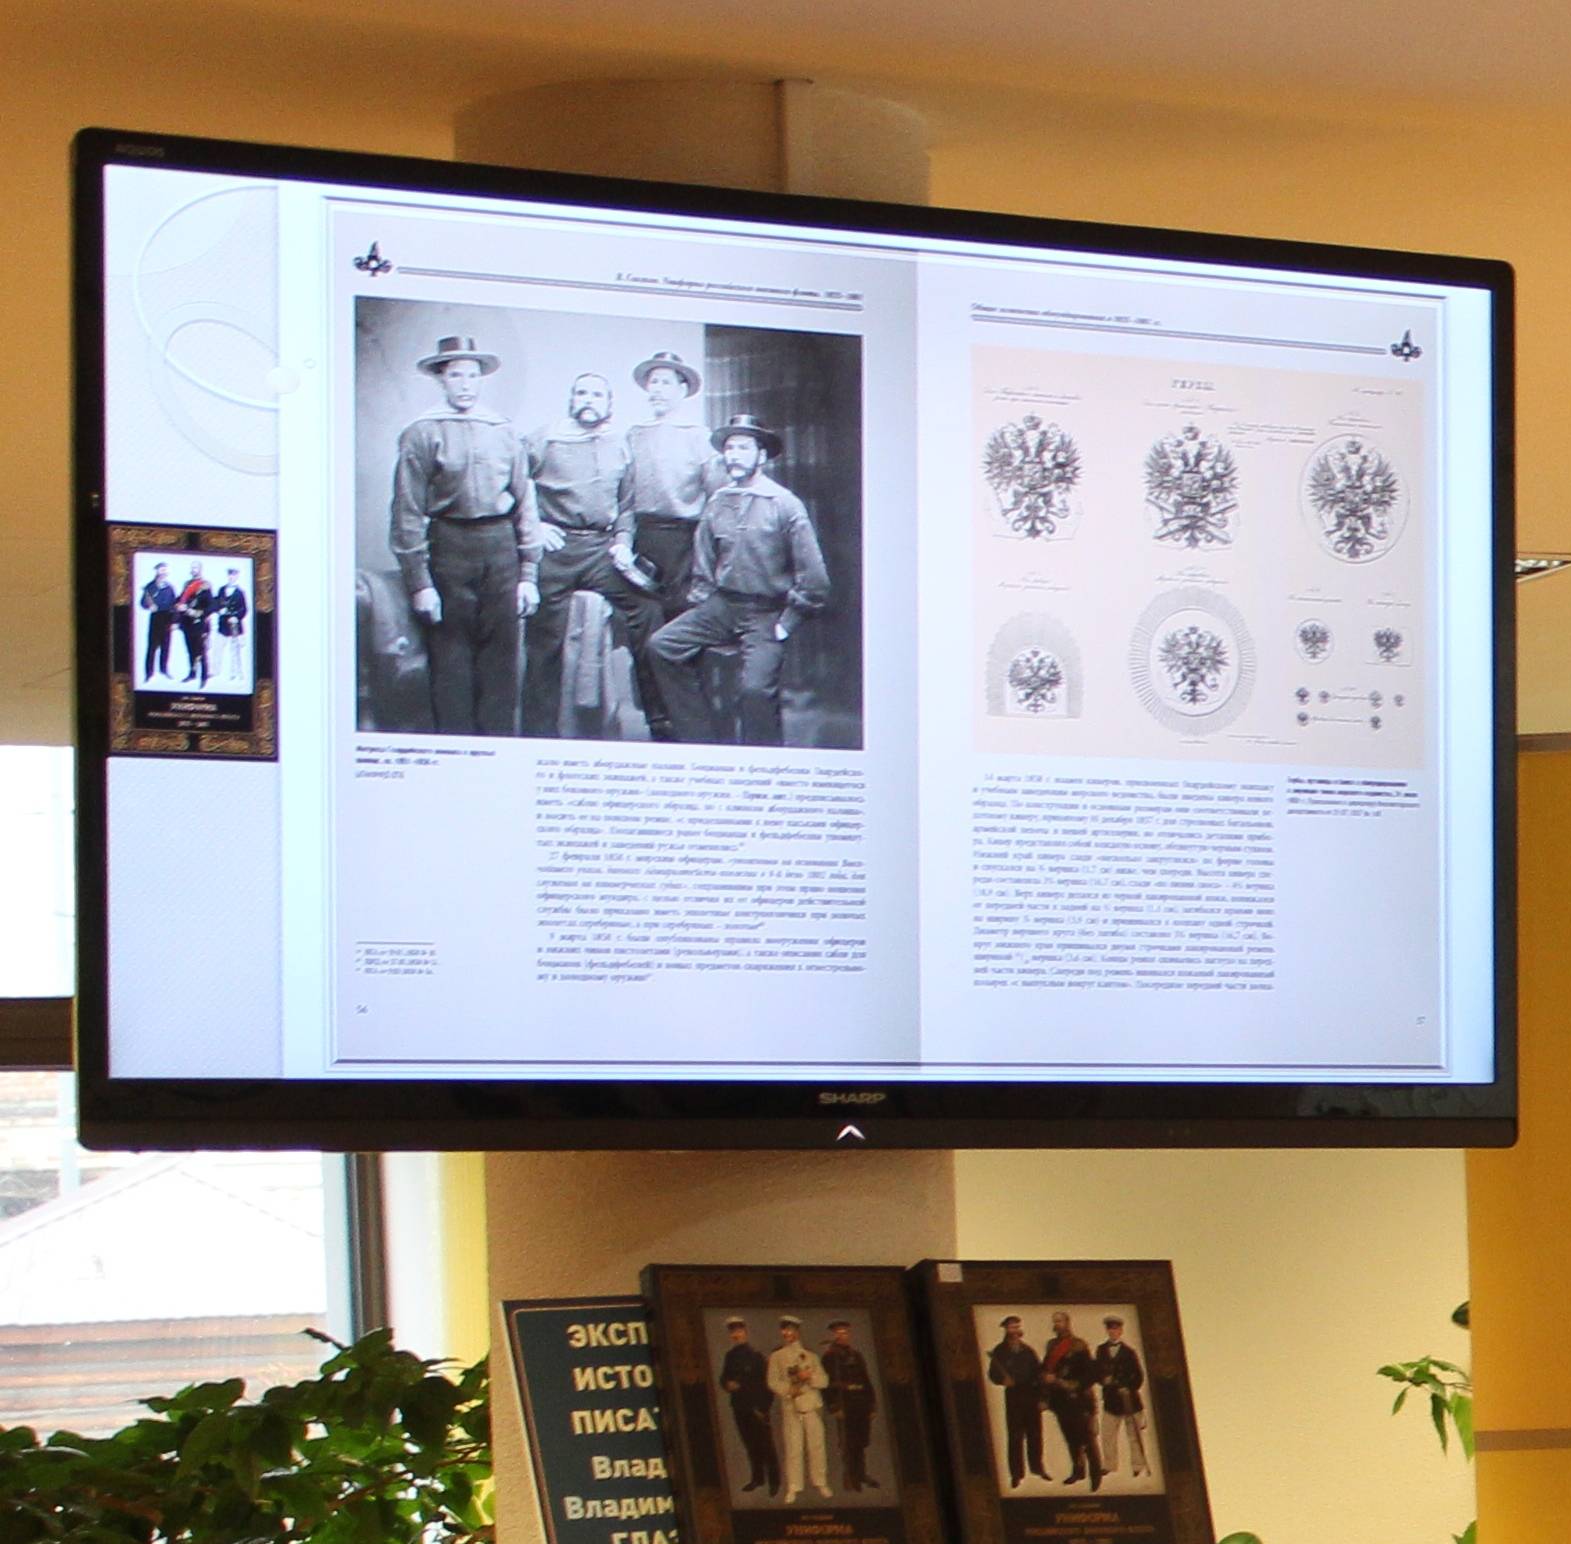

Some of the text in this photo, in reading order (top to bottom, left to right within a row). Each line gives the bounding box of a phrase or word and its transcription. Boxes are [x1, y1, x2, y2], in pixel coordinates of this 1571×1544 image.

[819, 1092, 886, 1104] SHARP
[567, 1321, 649, 1348] ЭКСП
[573, 1364, 654, 1391] ИСТО
[571, 1407, 660, 1435] ПИСА
[591, 1455, 668, 1480] Влад
[563, 1496, 675, 1520] Владим
